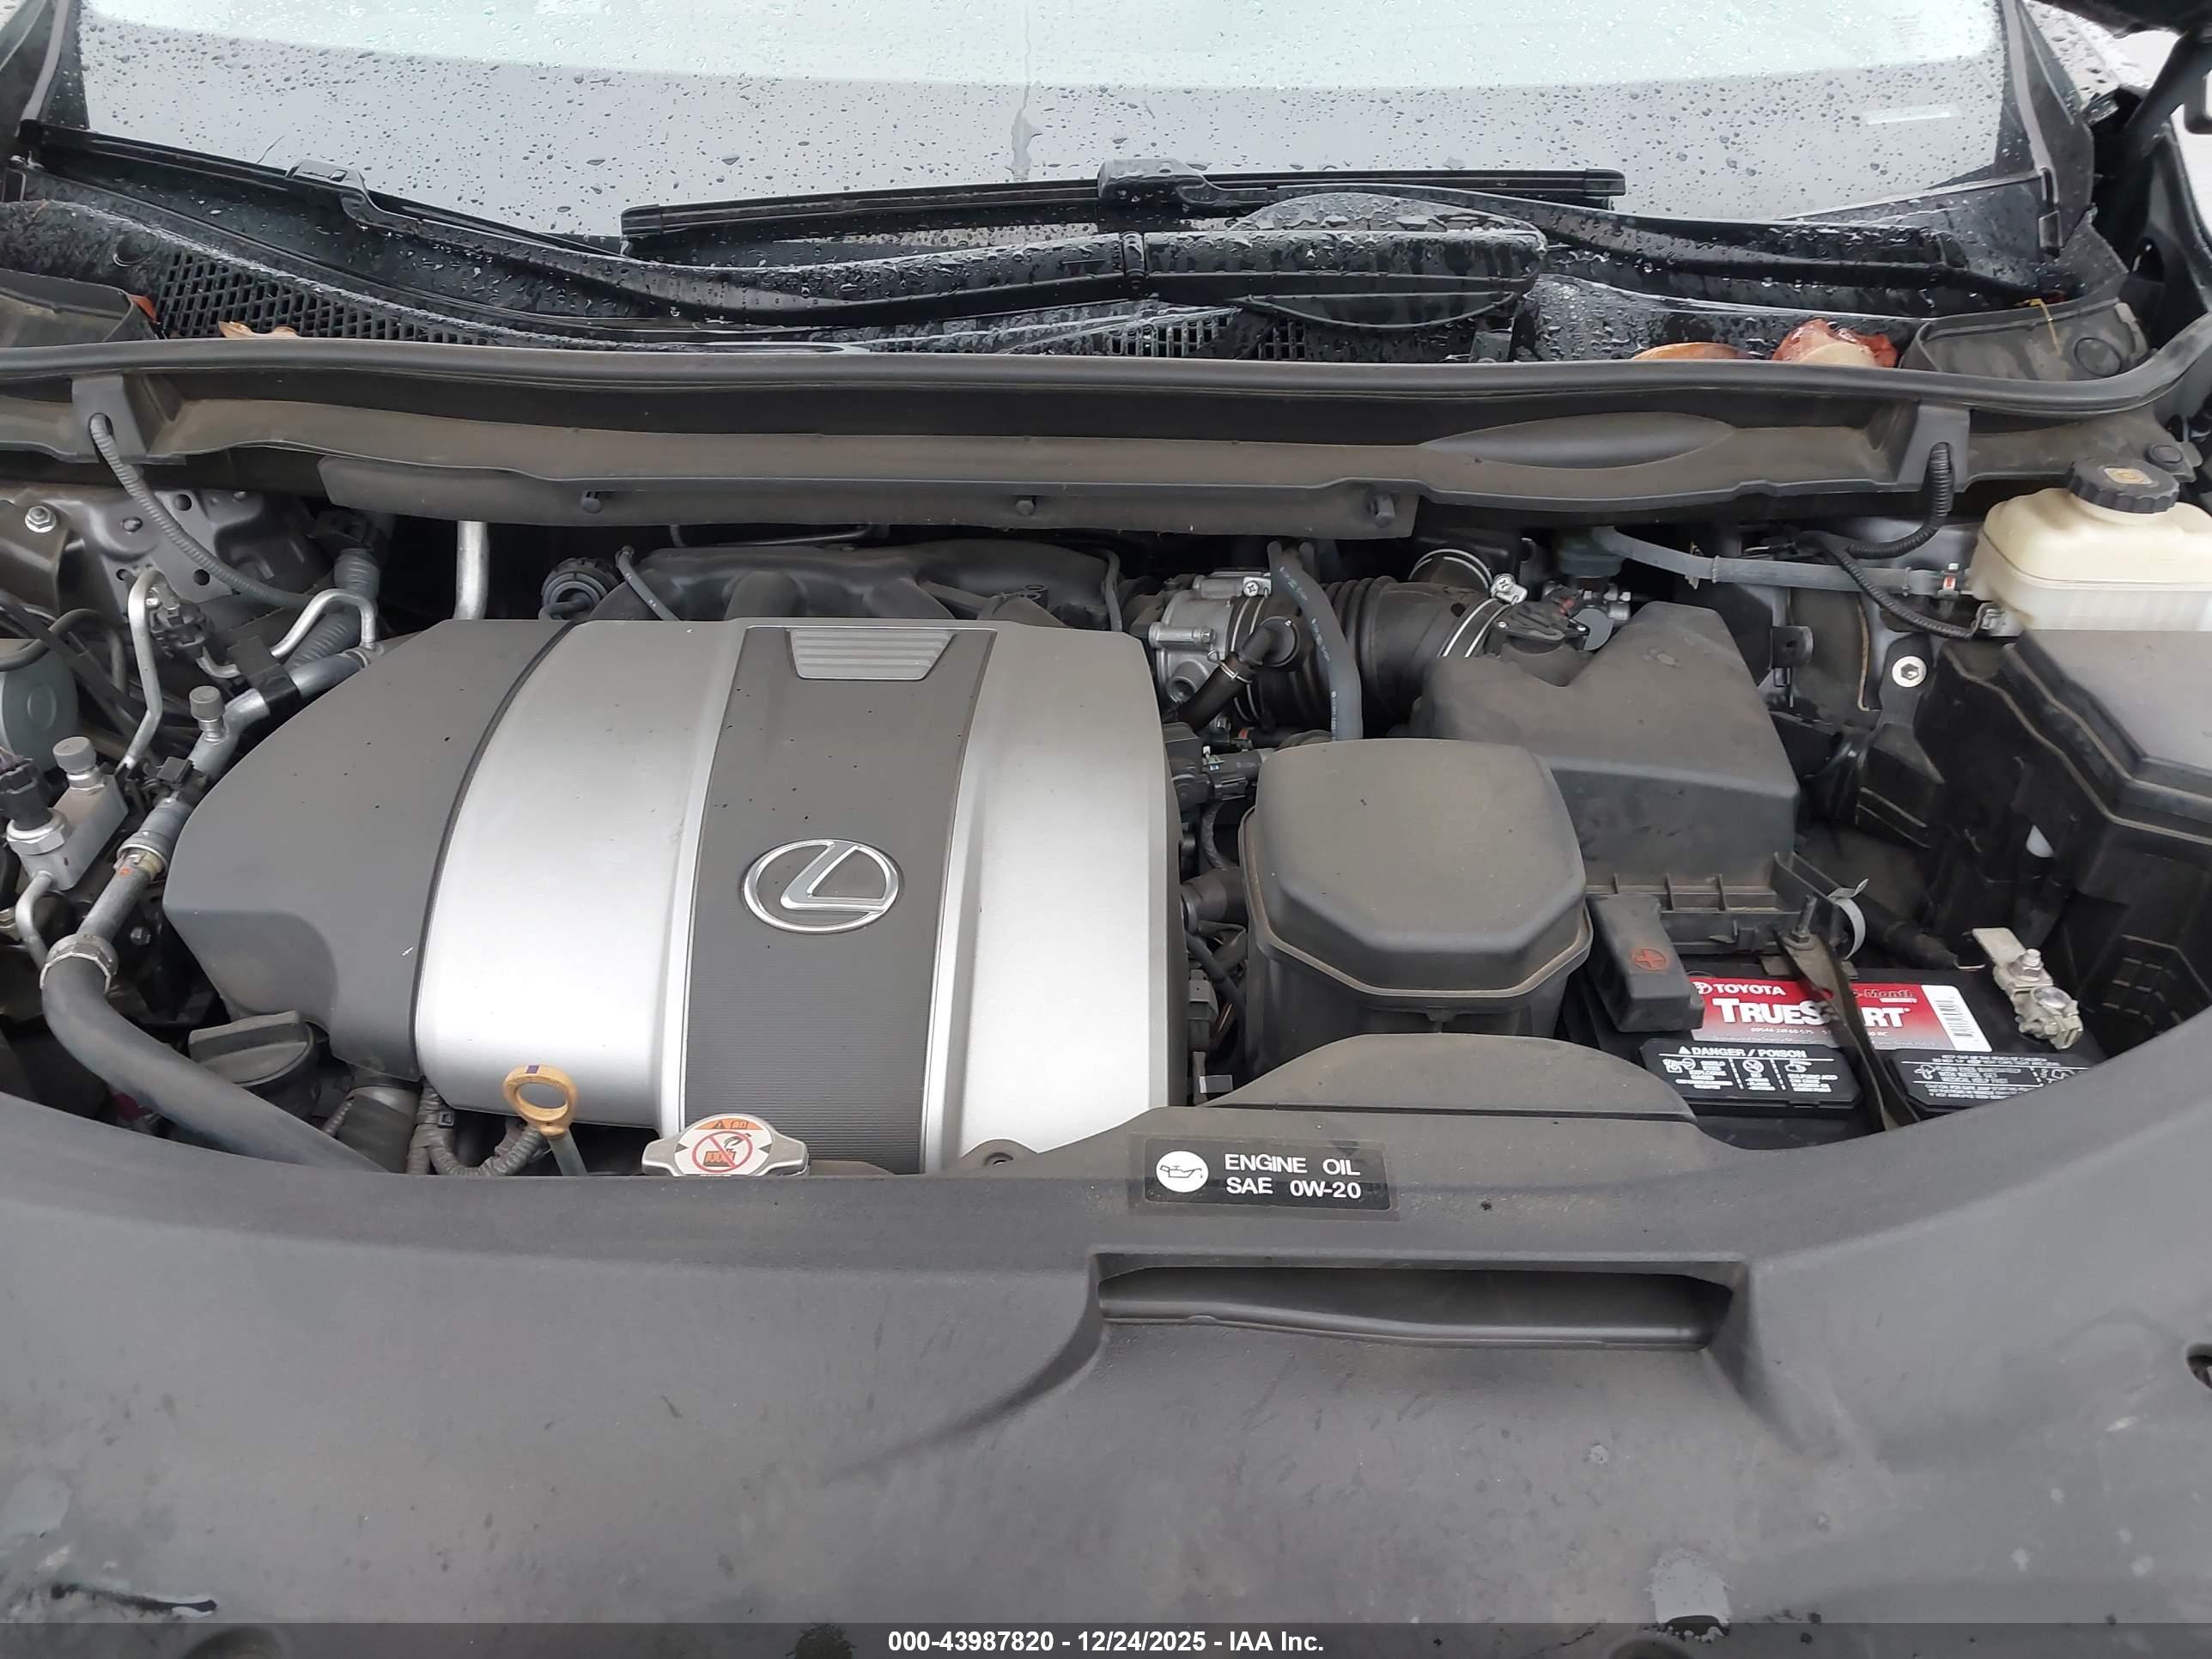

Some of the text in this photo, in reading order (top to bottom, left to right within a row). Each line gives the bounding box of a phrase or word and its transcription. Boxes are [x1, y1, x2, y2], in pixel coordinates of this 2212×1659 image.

[1713, 982, 1787, 996] TOYOTA
[1712, 998, 1905, 1028] TRUESRT
[1691, 1046, 1808, 1059] DANGER / POISON
[1224, 1153, 1361, 1176] ENGINE OIL
[1226, 1176, 1362, 1199] SAE 0W-20
